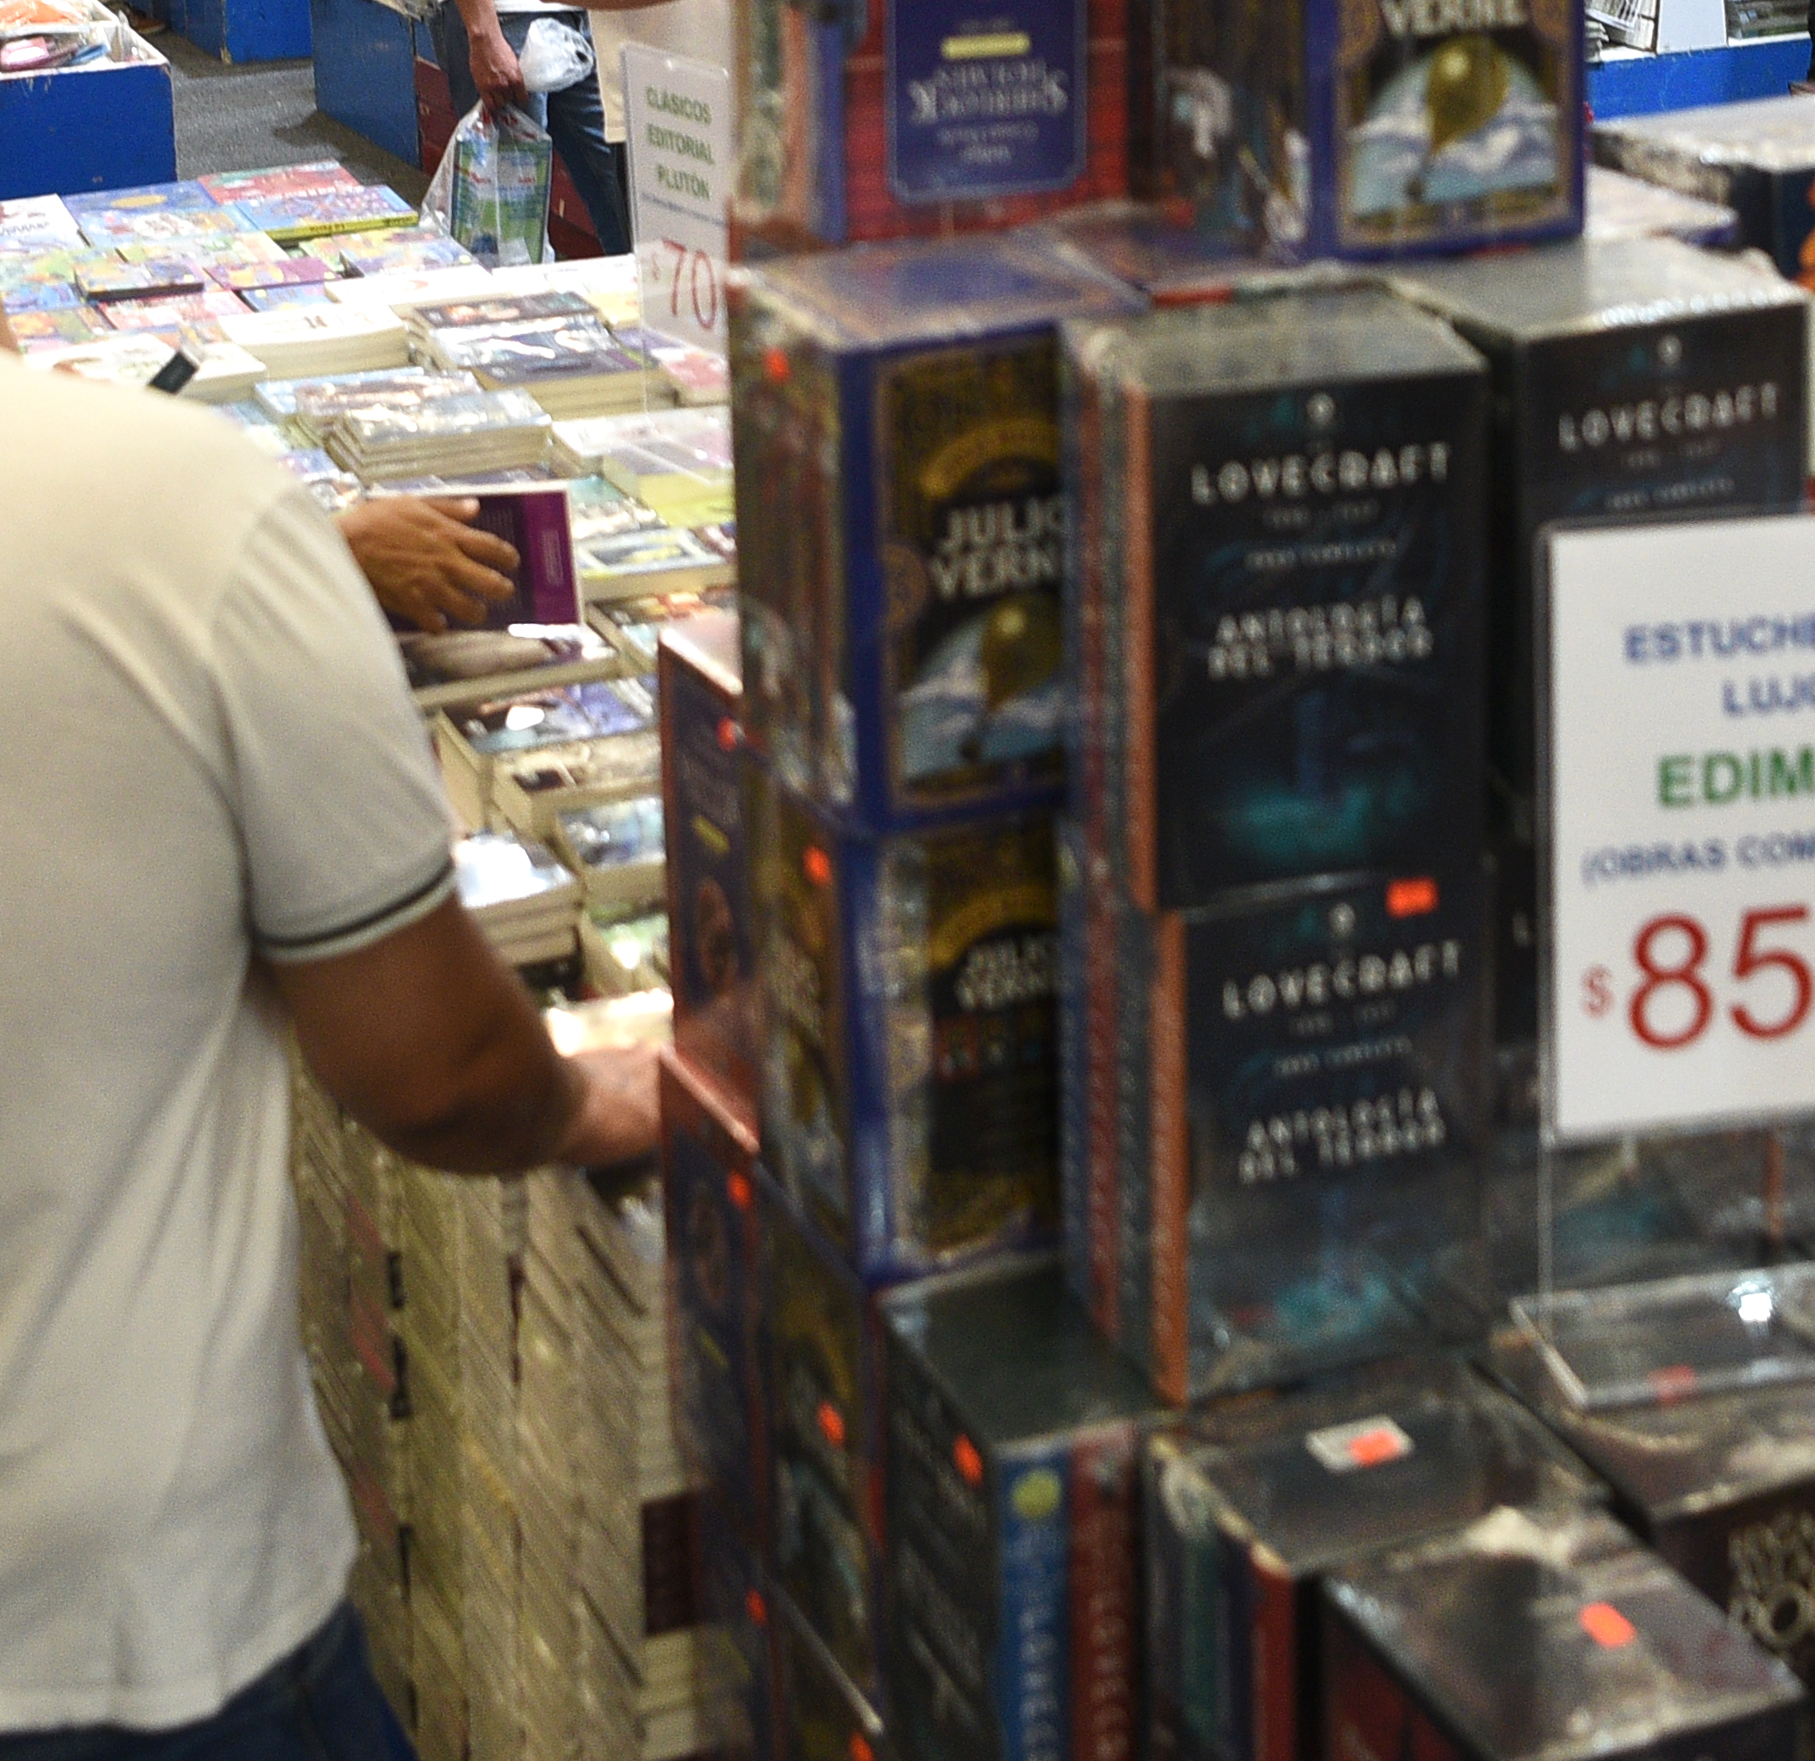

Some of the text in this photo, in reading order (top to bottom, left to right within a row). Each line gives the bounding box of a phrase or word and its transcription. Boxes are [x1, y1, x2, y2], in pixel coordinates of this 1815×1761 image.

[645, 85, 713, 125] CLÁSICOS
[645, 122, 715, 166] EDITORIAL
[656, 162, 711, 201] PLUTÓN
[1557, 383, 1779, 452] LOVECRAFT
[1190, 442, 1453, 506] LOVECRAFT
[925, 542, 1062, 600] VERN
[1583, 837, 1723, 886] (OBRAS
[955, 960, 1058, 1012] VERN
[1222, 941, 1465, 1021] LOVECRAFT
